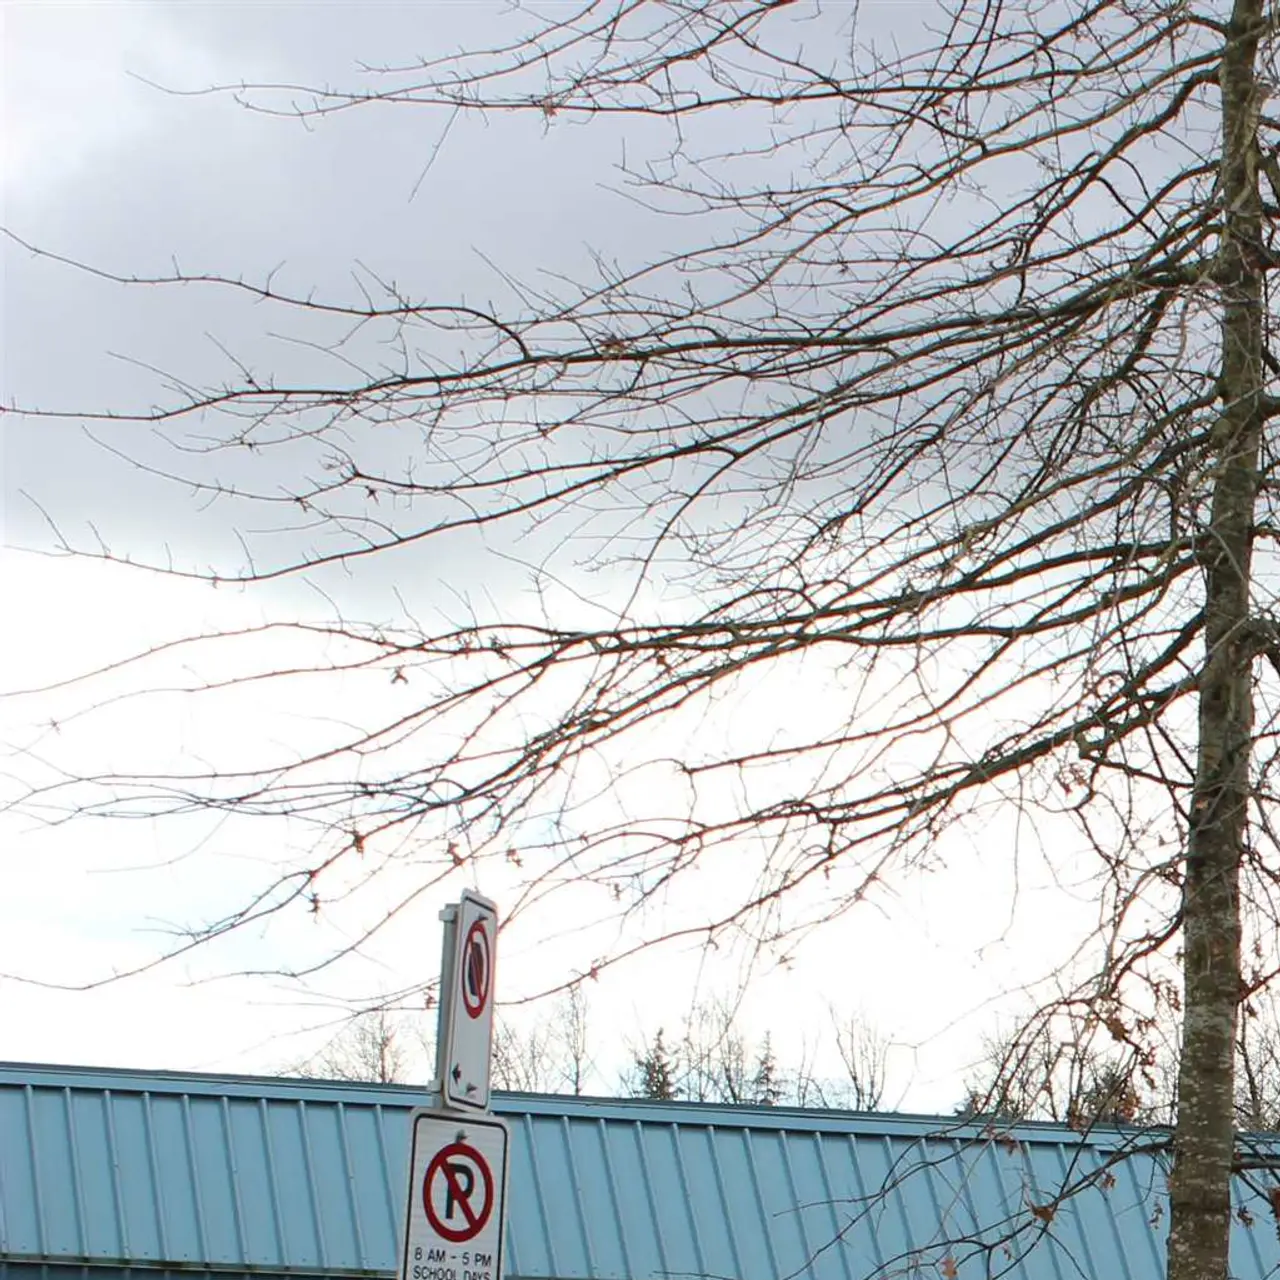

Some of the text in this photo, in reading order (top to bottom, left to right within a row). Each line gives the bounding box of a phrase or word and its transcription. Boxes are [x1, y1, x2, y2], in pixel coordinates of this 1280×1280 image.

[414, 1246, 423, 1261] 8
[427, 1248, 446, 1263] AM
[461, 1251, 470, 1266] 5
[474, 1252, 492, 1267] PM
